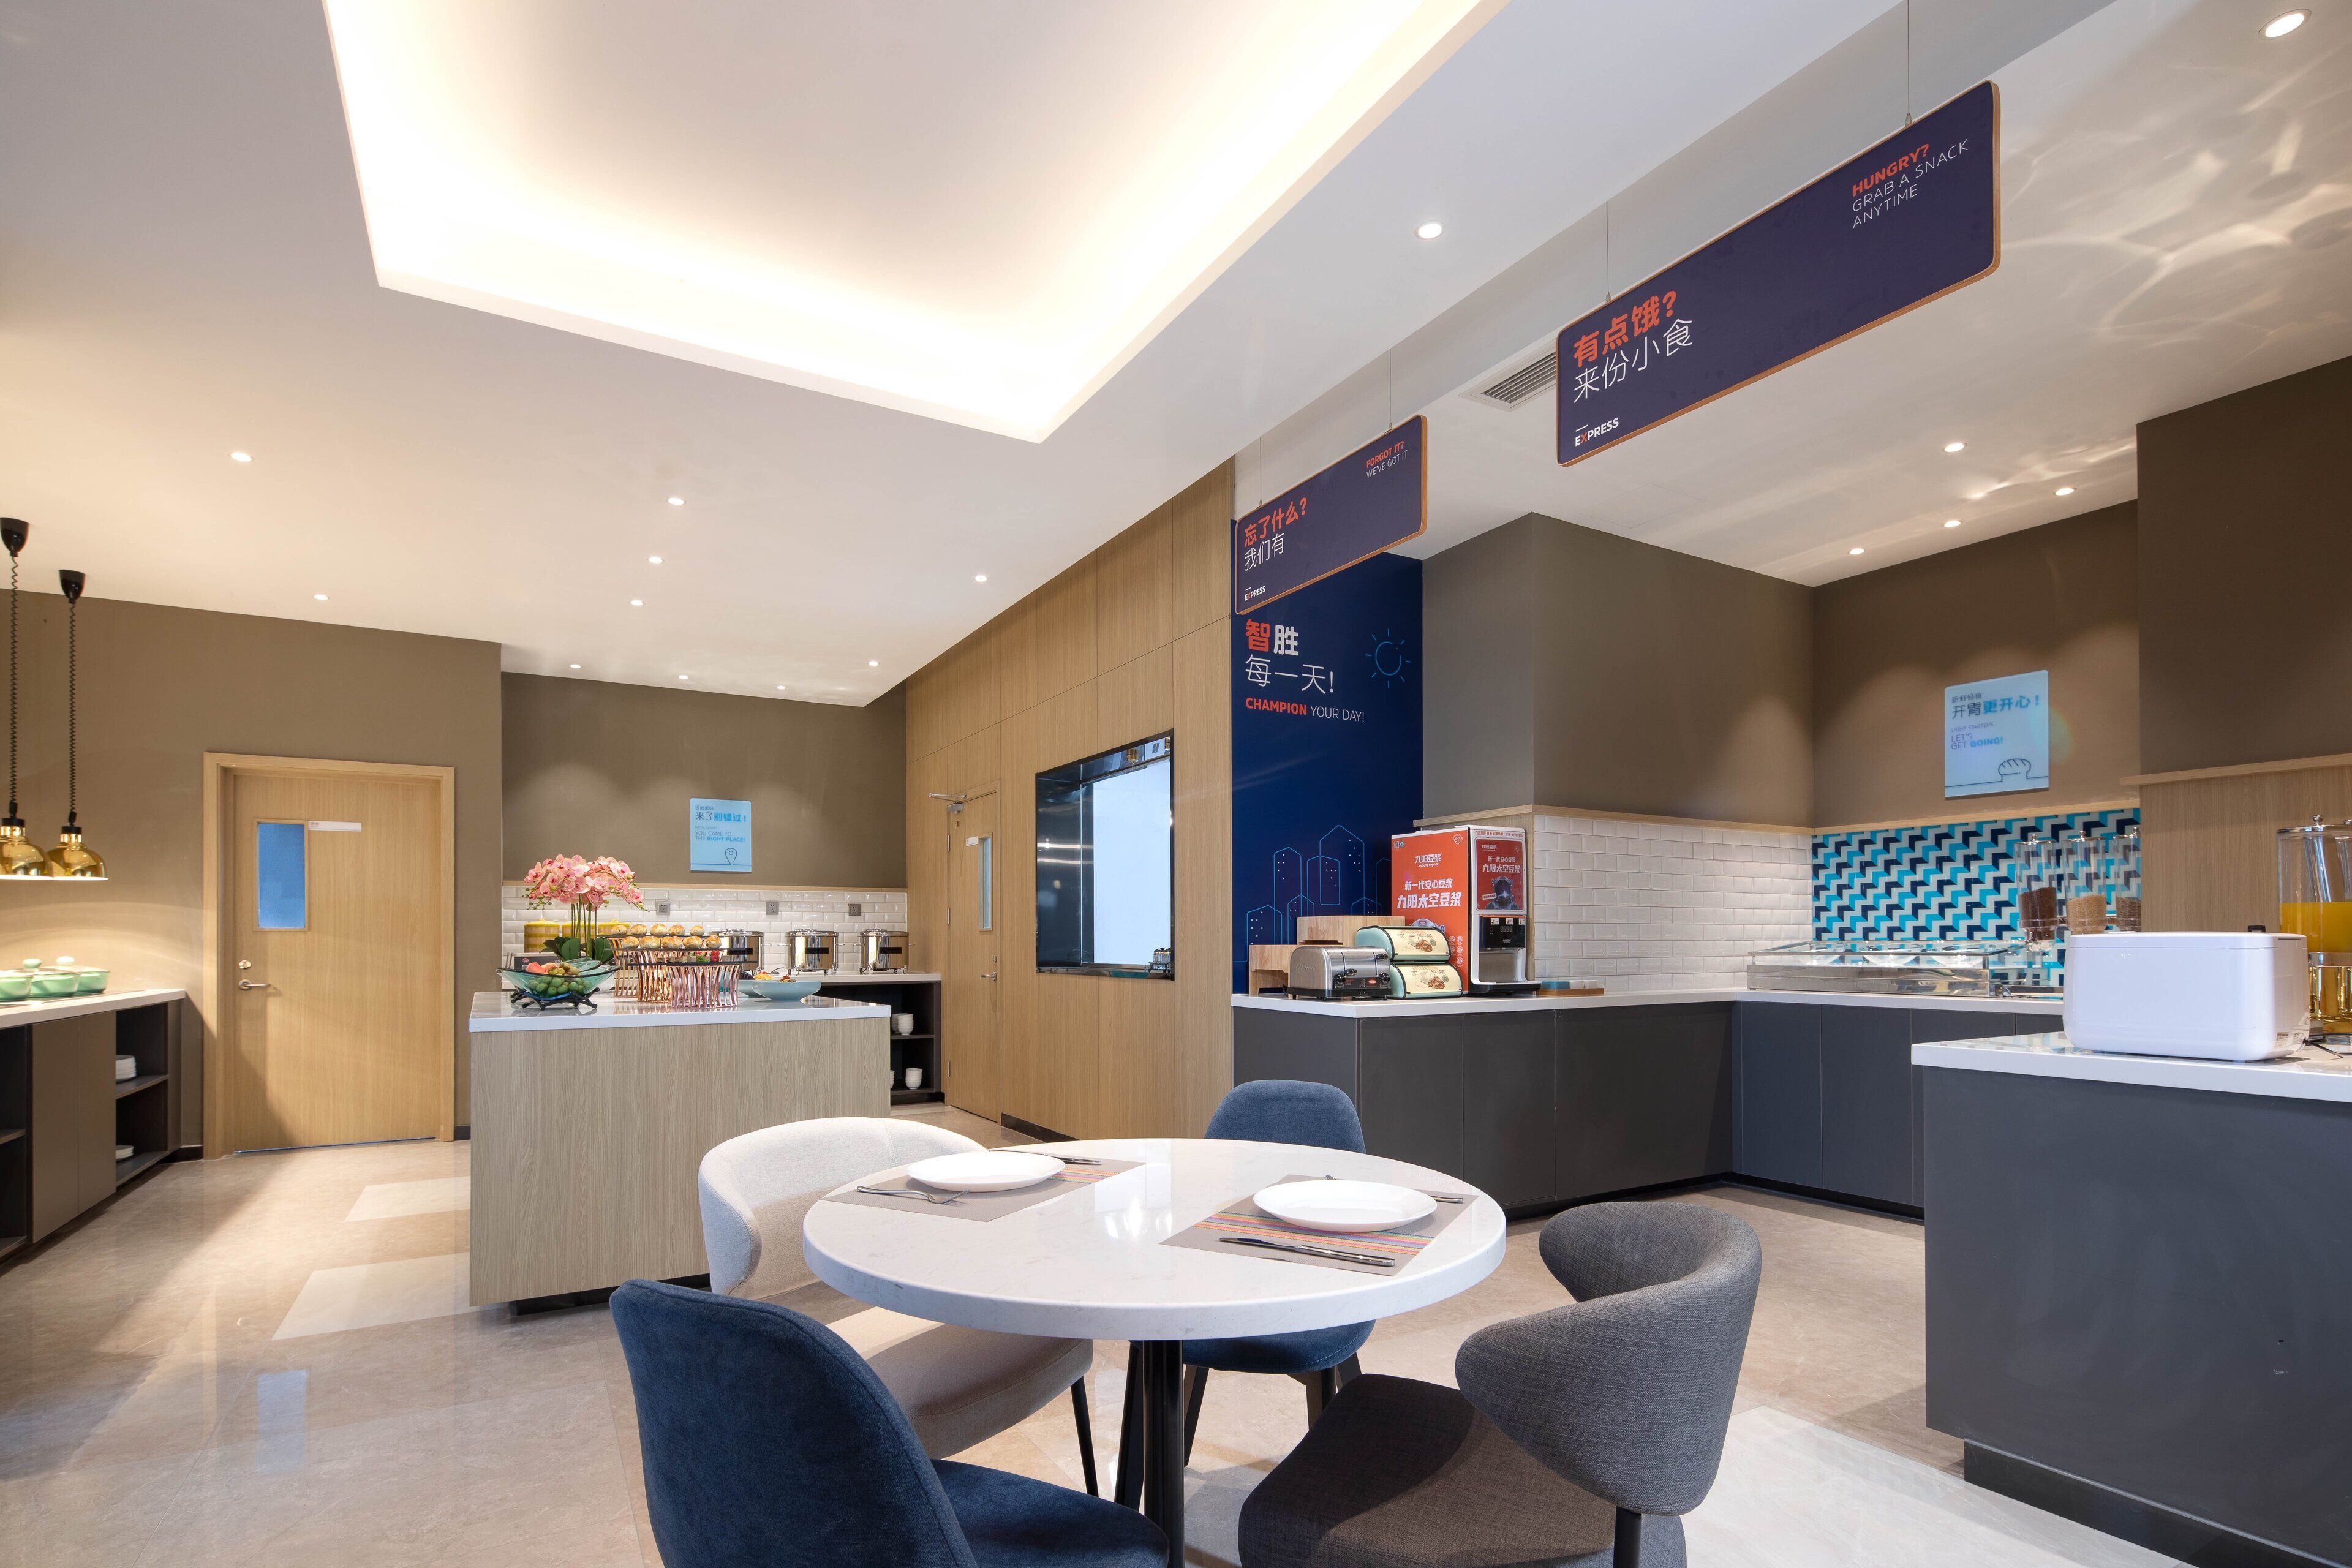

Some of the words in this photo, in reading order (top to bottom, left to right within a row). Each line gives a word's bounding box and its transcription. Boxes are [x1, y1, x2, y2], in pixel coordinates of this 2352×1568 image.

[1853, 143, 1929, 197] HUNGRY?
[1853, 181, 1894, 211] GRAB
[1899, 174, 1909, 187] A
[1915, 139, 1968, 178] SNACK
[1853, 184, 1917, 229] ANYTIME
[1574, 290, 1677, 368] 有点饿?
[1574, 318, 1692, 403] 来份小食
[1575, 417, 1619, 447] EXPRESS
[1366, 447, 1392, 469] FORGOT
[1394, 440, 1404, 453] IT?
[1366, 462, 1385, 478] WE'VE
[1387, 453, 1400, 467] GOT
[1402, 450, 1408, 459] IT
[1244, 497, 1308, 547] 忘了什么?
[1245, 533, 1284, 571] 我们有
[1245, 586, 1266, 601] EXPRESS
[1245, 619, 1299, 656] 智胜
[1245, 654, 1334, 695] 每一天!
[1245, 697, 1307, 715] CHAMPION
[1310, 705, 1339, 720] YOUR
[1343, 709, 1365, 723] DAY!
[1951, 733, 1972, 742] LET'S
[1970, 737, 2003, 747] GOING!
[1415, 853, 1441, 864] 九阳豆浆
[1404, 878, 1453, 891] 新一代安心豆浆
[1396, 891, 1462, 909] 九阳太空豆浆
